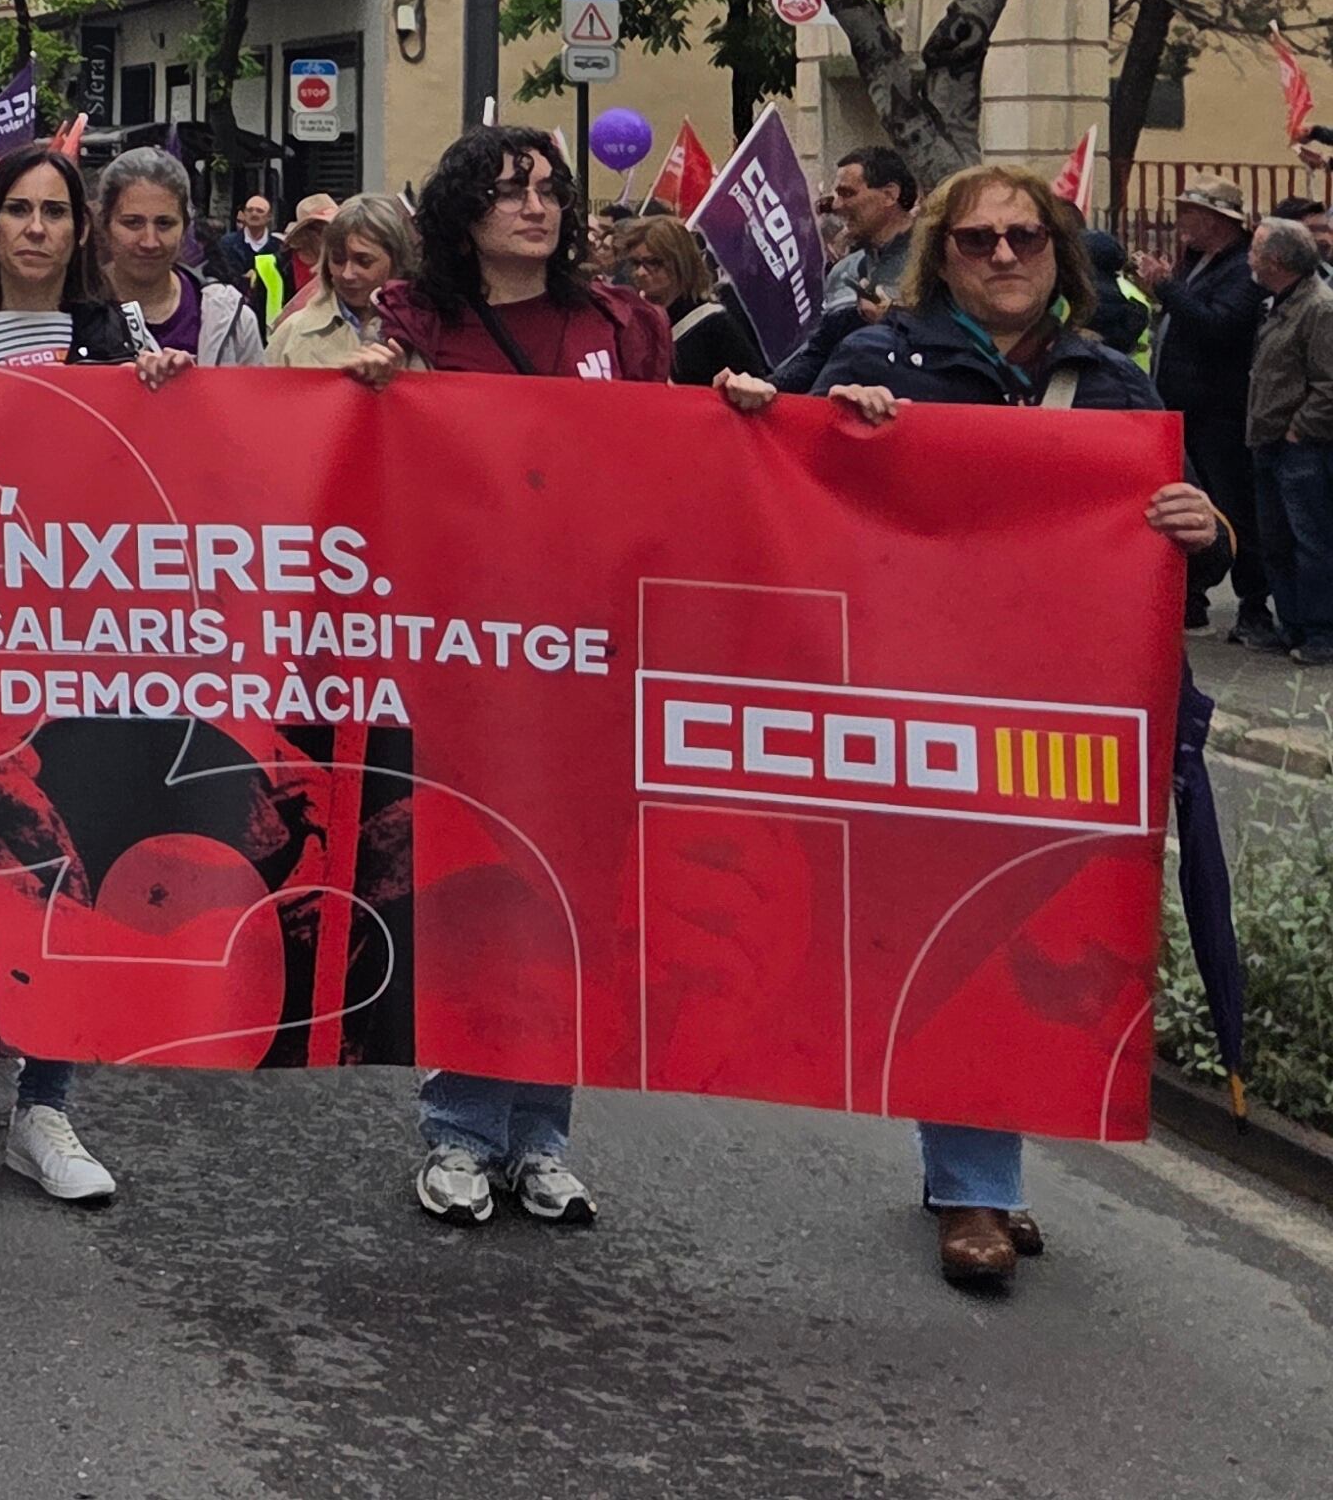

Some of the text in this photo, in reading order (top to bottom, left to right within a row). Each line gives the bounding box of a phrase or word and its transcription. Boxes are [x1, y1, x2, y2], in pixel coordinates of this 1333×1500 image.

[300, 87, 327, 98] STOP
[741, 155, 800, 272] CCOO
[261, 608, 611, 677] HABITATGE
[662, 699, 981, 795] CCOO
